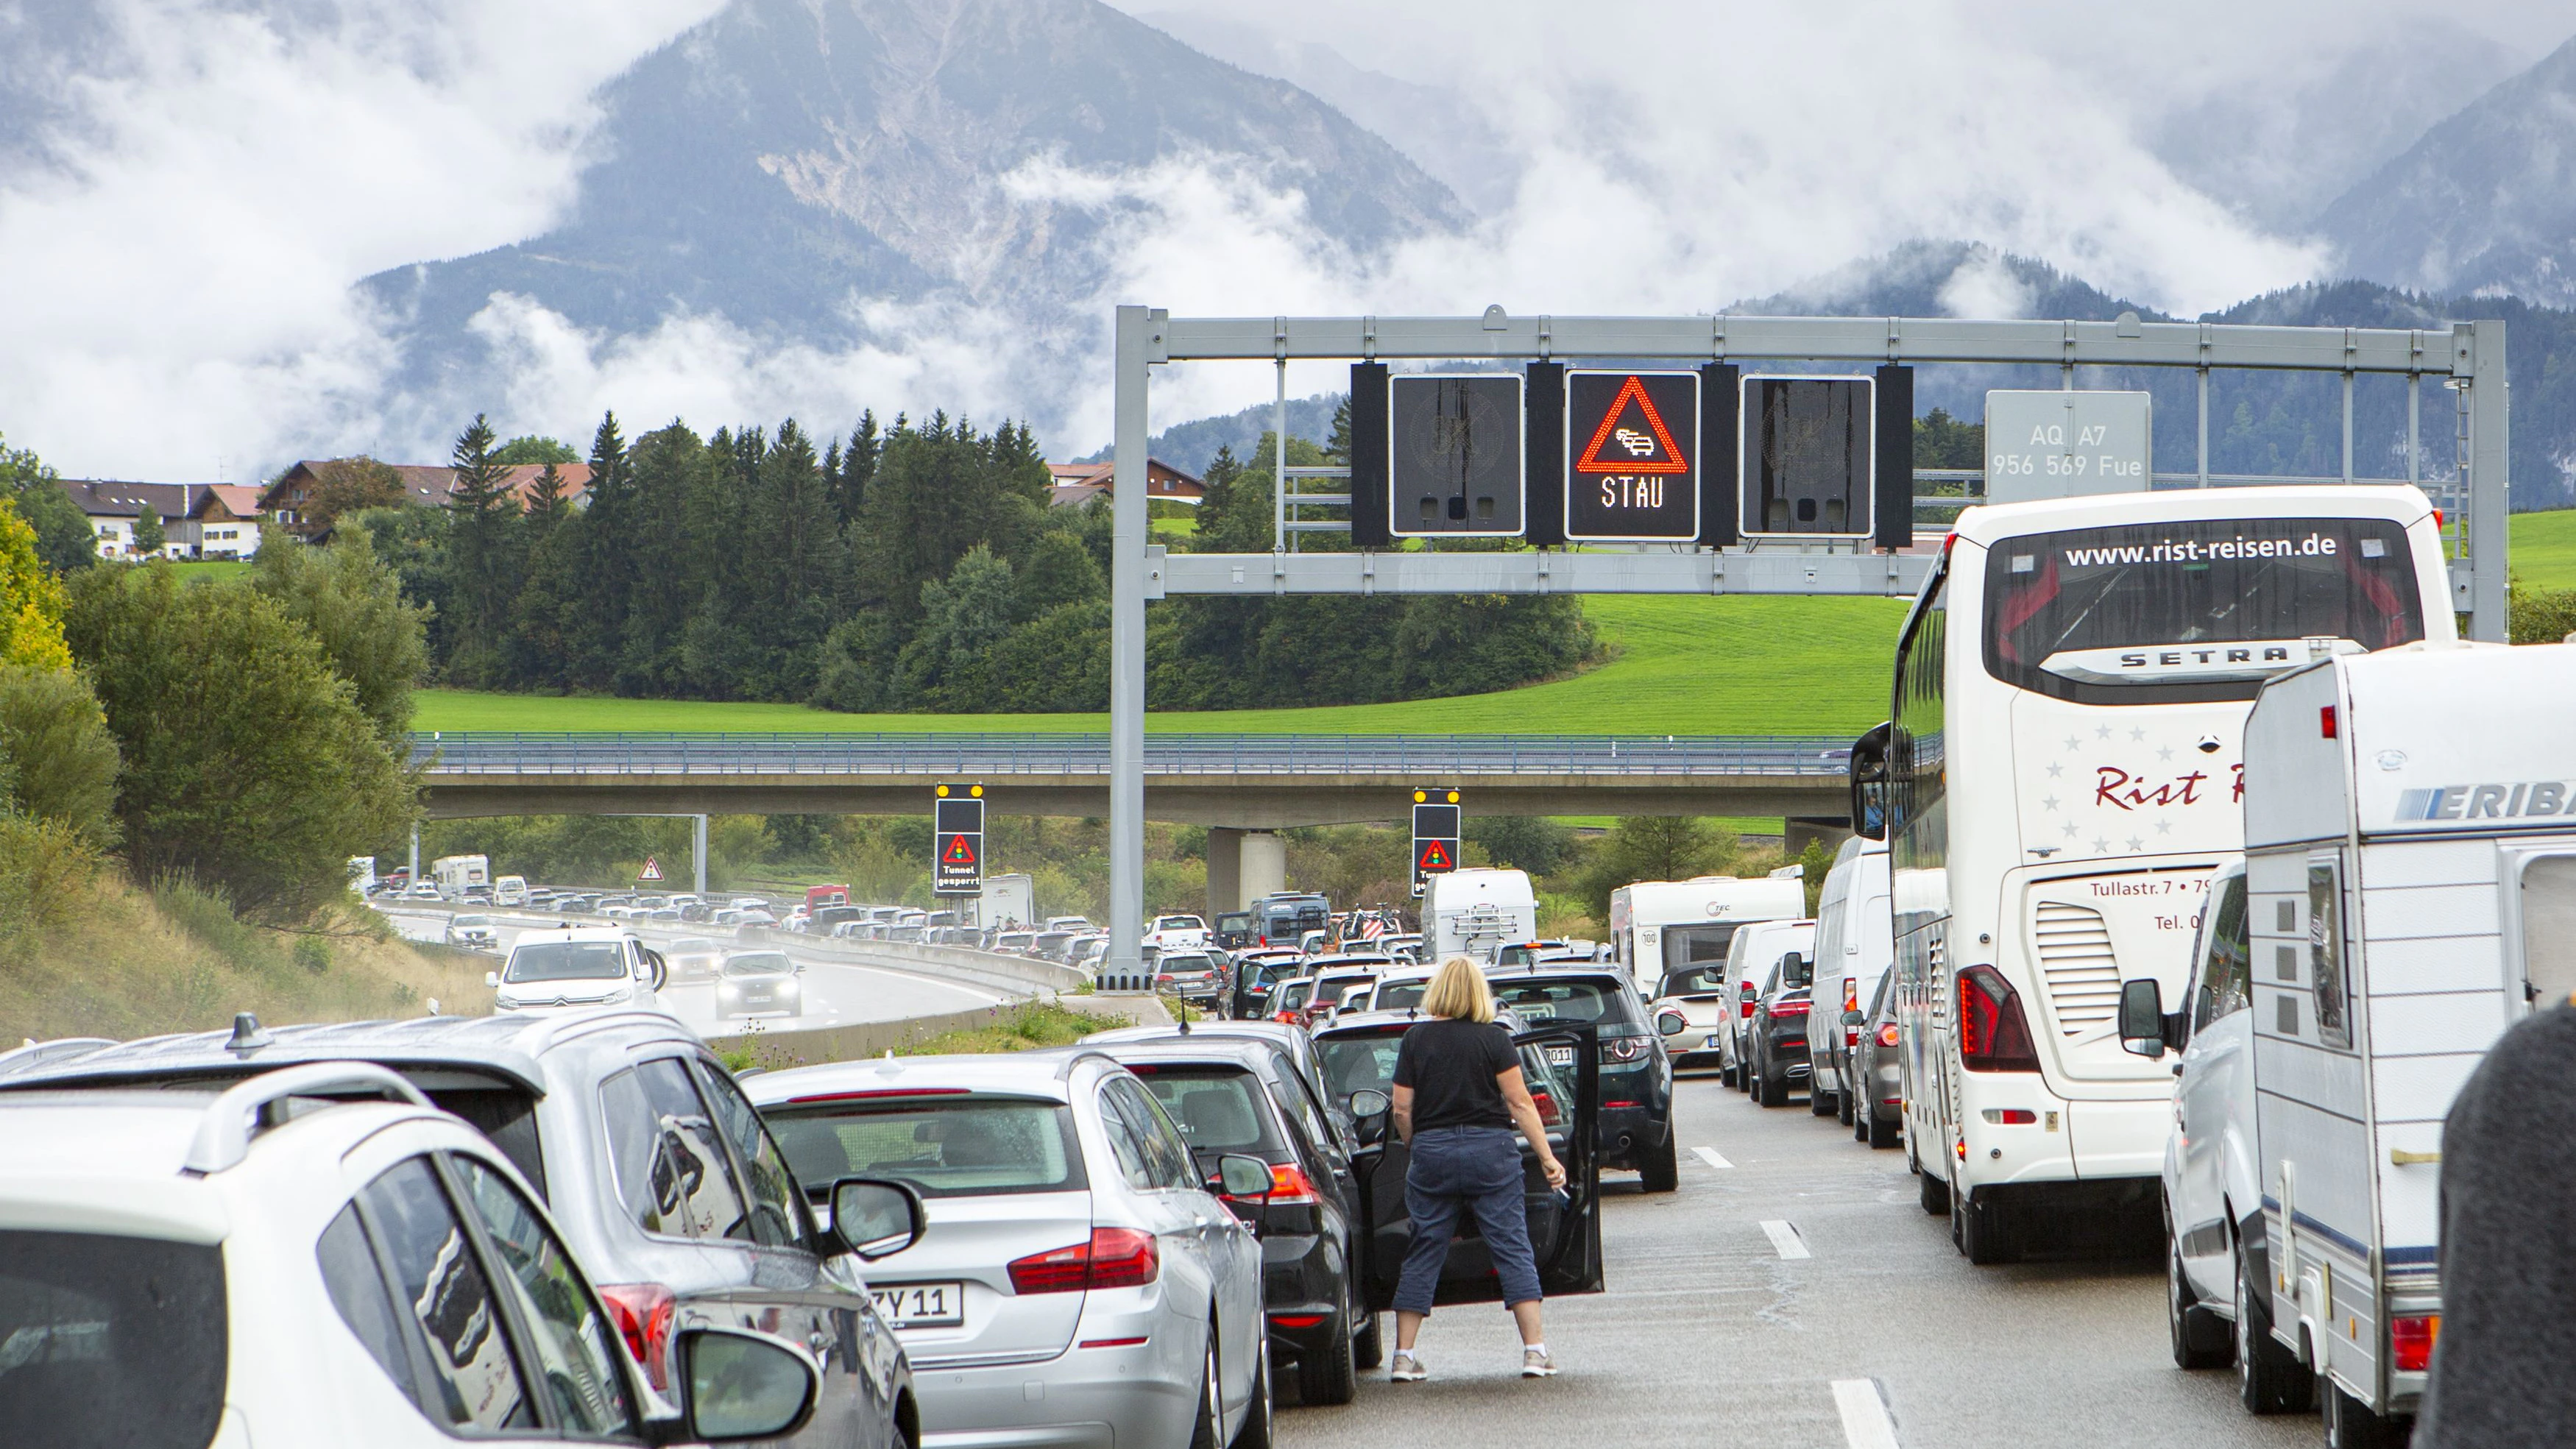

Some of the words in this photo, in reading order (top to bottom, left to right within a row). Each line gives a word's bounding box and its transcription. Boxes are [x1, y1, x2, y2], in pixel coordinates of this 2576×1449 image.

[2030, 425, 2064, 445] AQ
[2078, 425, 2106, 446] A7
[1993, 455, 2034, 475] 956
[2046, 456, 2087, 476] 569
[2099, 456, 2142, 476] Fue
[1602, 476, 1663, 508] STAU
[2066, 533, 2336, 566] www.rist-reisen.de
[2121, 648, 2288, 667] SETRA
[2096, 767, 2207, 810] Rist
[2435, 782, 2576, 818] ERIB
[943, 865, 975, 874] Tunnel
[938, 876, 980, 887] gesperrt
[2091, 882, 2158, 896] Tullastr.
[2163, 881, 2171, 894] 7
[2155, 916, 2183, 929] Tel.
[1643, 933, 1656, 943] 100
[913, 1289, 947, 1317] 11
